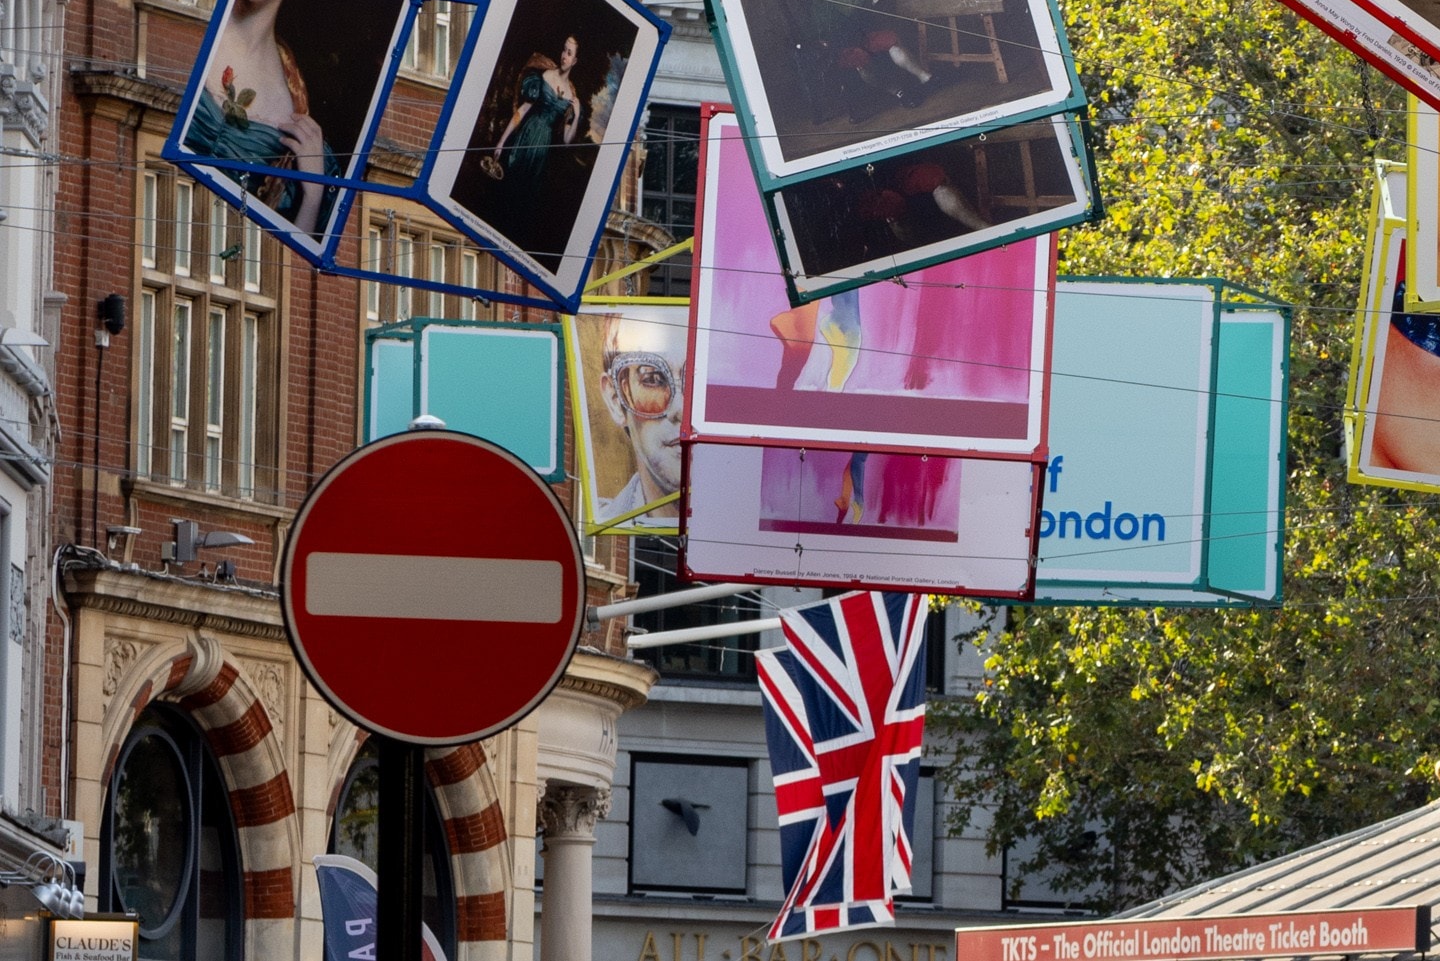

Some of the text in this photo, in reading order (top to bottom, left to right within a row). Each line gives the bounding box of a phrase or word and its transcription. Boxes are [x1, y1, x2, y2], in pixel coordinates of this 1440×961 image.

[1314, 0, 1329, 11] Anna
[1326, 8, 1340, 21] May
[1338, 17, 1355, 32] Wong
[1353, 27, 1362, 36] by
[1361, 32, 1374, 43] Fred
[1371, 40, 1394, 59] Daniels,
[1393, 55, 1406, 66] 1929
[1412, 67, 1429, 82] Estate
[1427, 78, 1435, 86] of
[1048, 456, 1063, 492] f
[1040, 501, 1165, 541] ondon
[56, 937, 131, 951] CLAUDE'S
[56, 952, 72, 960] Fish
[83, 953, 115, 961] Seafood
[1001, 936, 1036, 961] TKTS
[1054, 933, 1079, 960] The
[1084, 928, 1139, 958] Official
[1143, 926, 1201, 956] London
[1205, 924, 1264, 952] Theatre
[1269, 921, 1316, 950] Ticket
[1320, 917, 1368, 948] Booth
